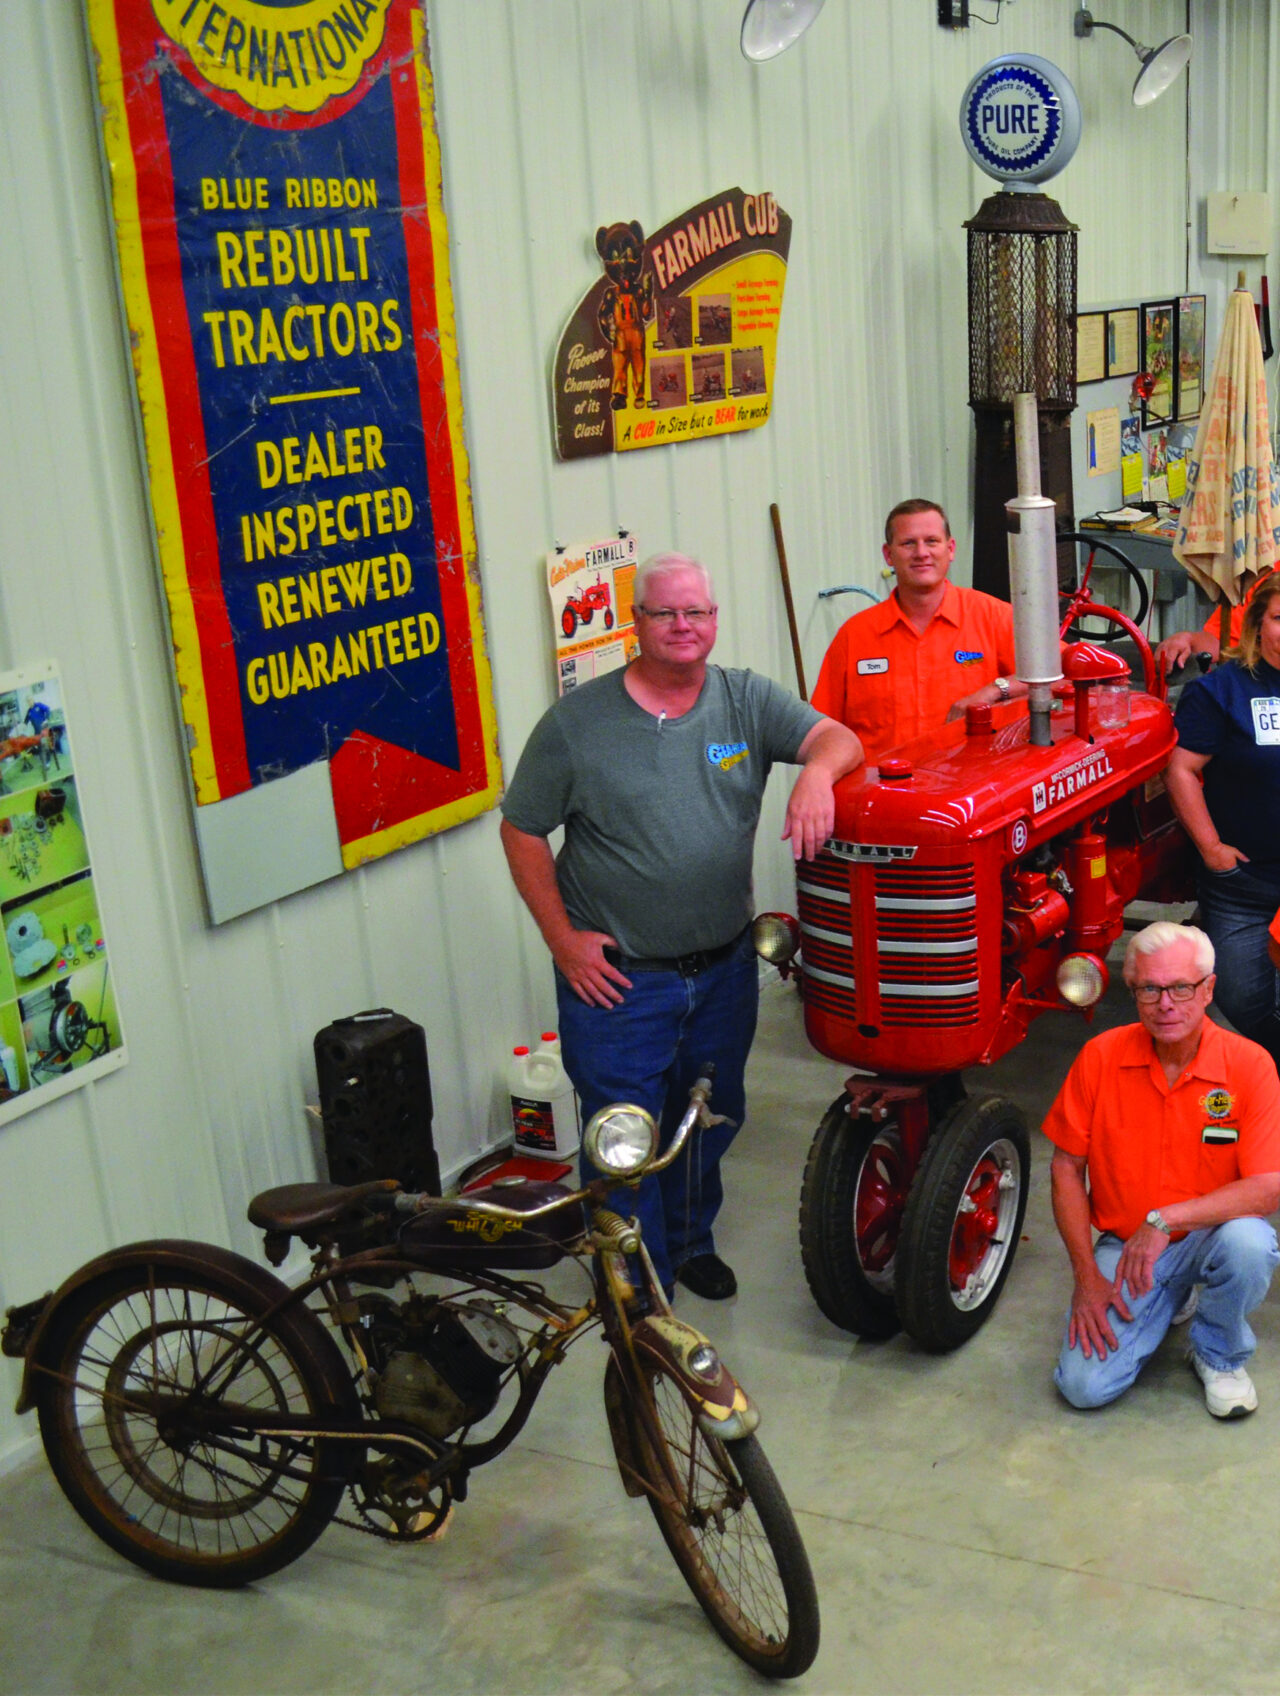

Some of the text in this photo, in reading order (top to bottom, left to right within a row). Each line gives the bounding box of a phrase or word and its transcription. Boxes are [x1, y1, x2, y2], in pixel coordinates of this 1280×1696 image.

[986, 83, 1014, 101] PRODUCTS
[982, 104, 1040, 134] PURE
[1001, 147, 1011, 155] OIL
[1013, 136, 1039, 155] COMPANY
[202, 178, 378, 210] BLUE RIBBON
[216, 227, 371, 288] REBUILT
[651, 194, 779, 290] FARMALL CUB
[203, 299, 402, 368] TRACTORS
[567, 343, 608, 375] Proven
[563, 375, 611, 394] Champion
[574, 399, 601, 415] of its
[623, 425, 632, 442] A
[634, 420, 656, 440] CUB
[656, 417, 665, 434] in
[668, 416, 687, 433] Size
[690, 410, 704, 428] but
[715, 405, 736, 425] BEAR
[737, 405, 749, 421] for
[750, 402, 769, 419] work
[574, 420, 606, 439] Class!
[256, 425, 386, 489] DEALER
[241, 486, 413, 562] INSPECTED
[586, 544, 625, 568] FARMALL
[257, 552, 412, 630] RENEWED
[247, 612, 440, 705] GUARANTEED
[1049, 757, 1113, 805] FARMALL
[830, 841, 910, 857] ARMALL
[1016, 826, 1026, 849] B
